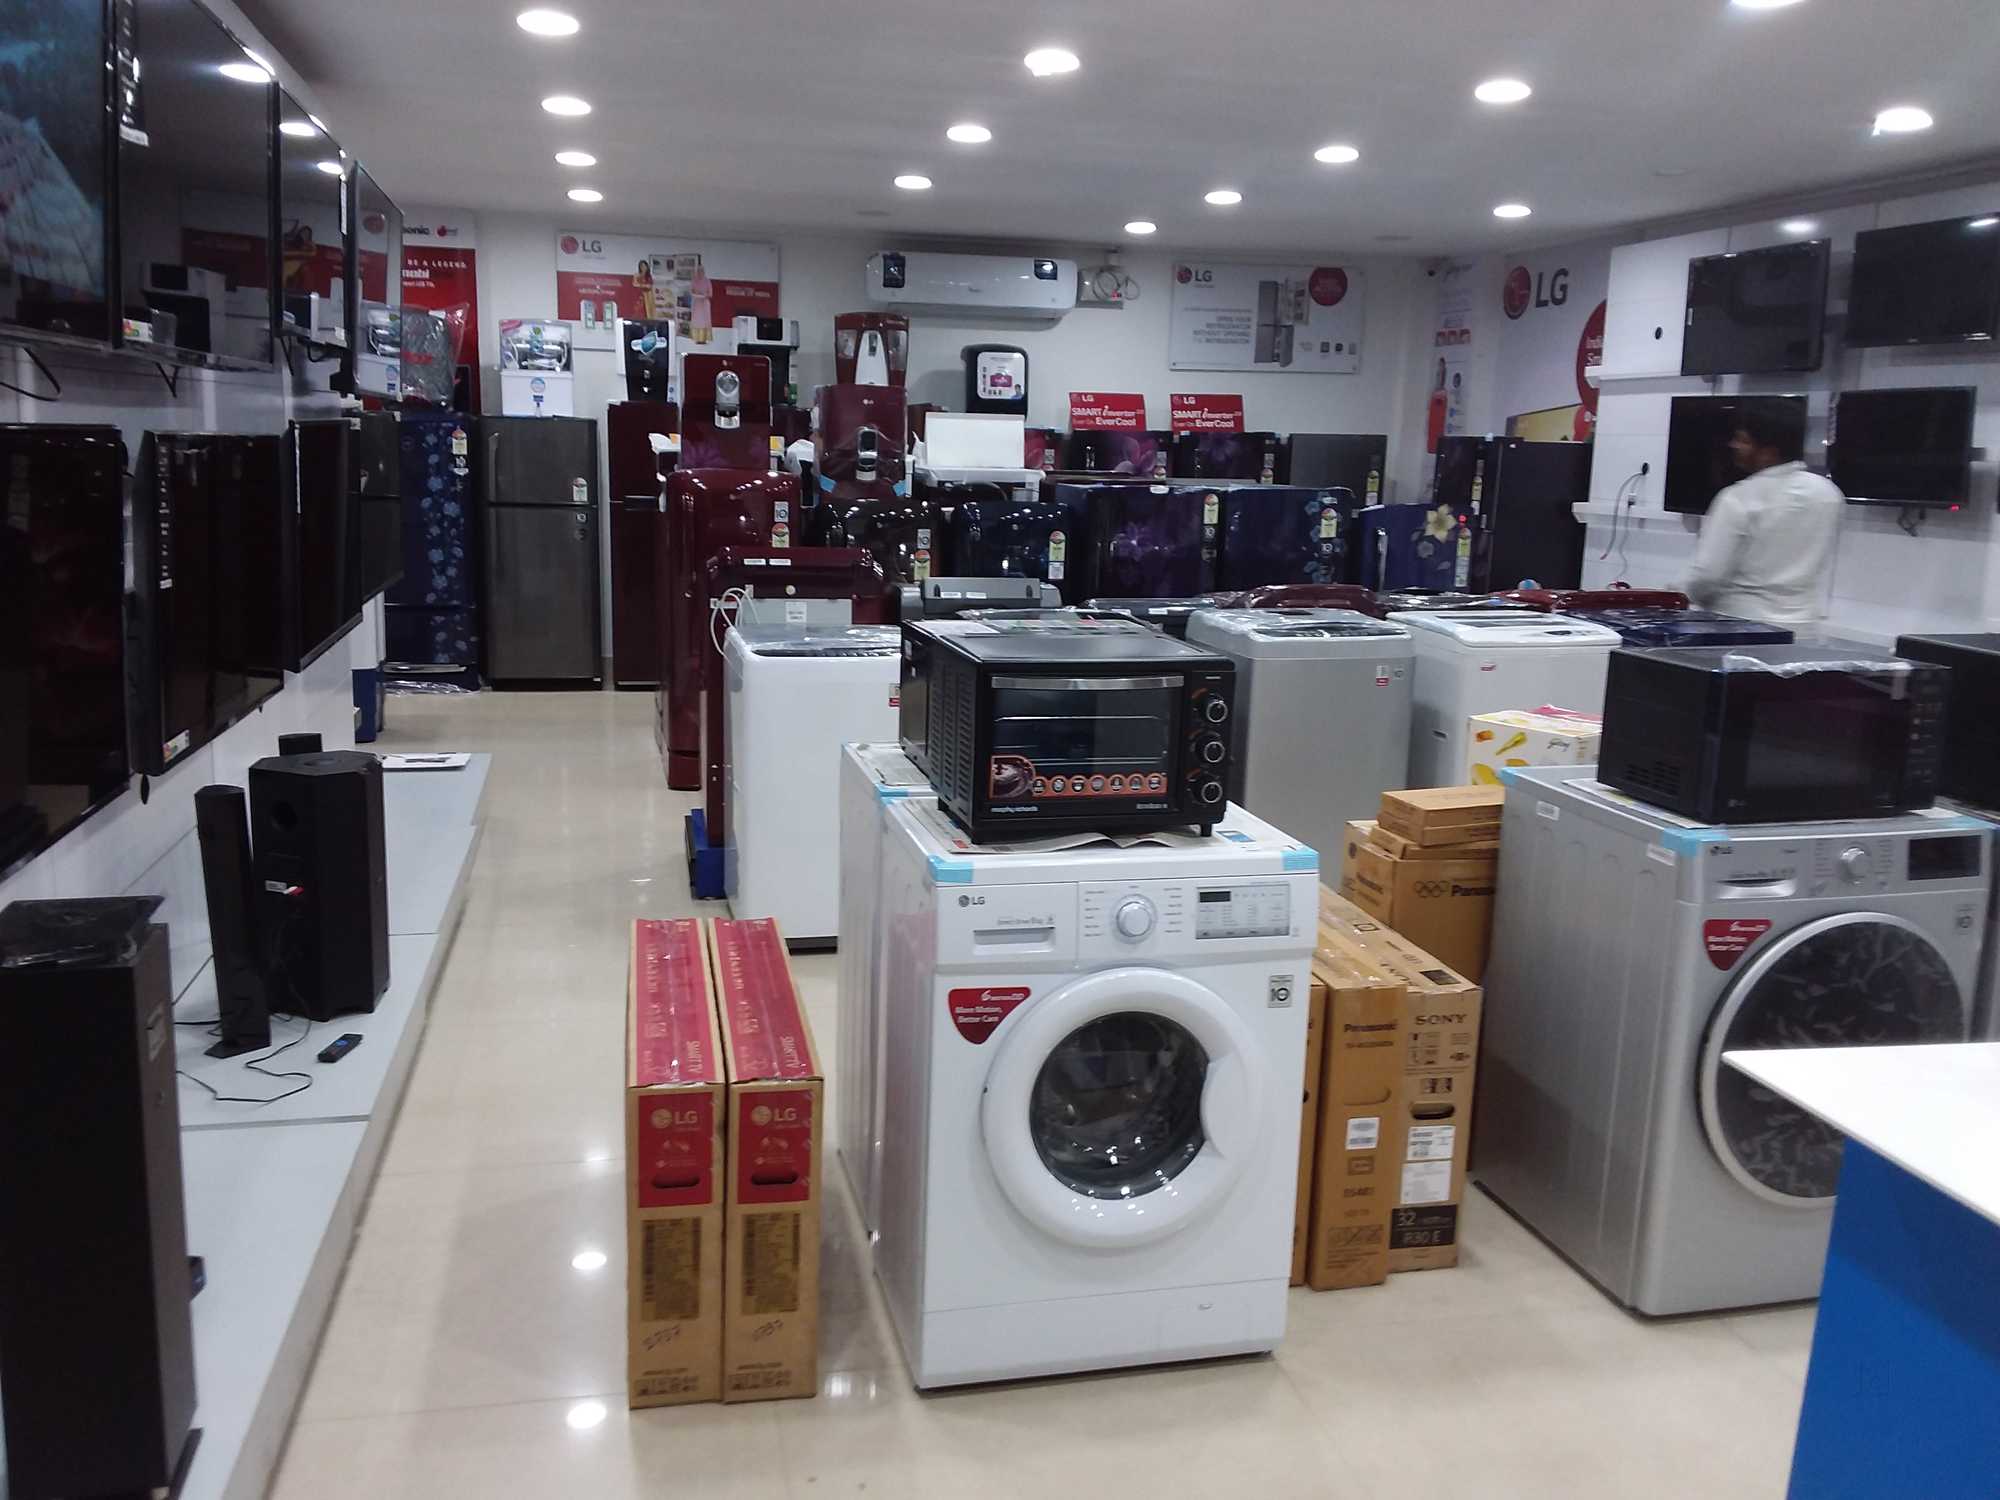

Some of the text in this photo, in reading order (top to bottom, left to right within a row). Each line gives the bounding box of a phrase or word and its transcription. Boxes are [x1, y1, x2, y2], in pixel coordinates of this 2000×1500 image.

[582, 240, 602, 253] LG
[1195, 270, 1213, 282] LG
[1535, 268, 1569, 308] LG
[1082, 394, 1094, 402] LG
[1183, 396, 1196, 404] LG
[1071, 408, 1102, 416] SMART
[1172, 410, 1202, 418] SMART
[972, 896, 985, 905] LG
[1415, 1014, 1467, 1025] SONY
[674, 1111, 698, 1125] LG
[774, 1108, 797, 1122] LG
